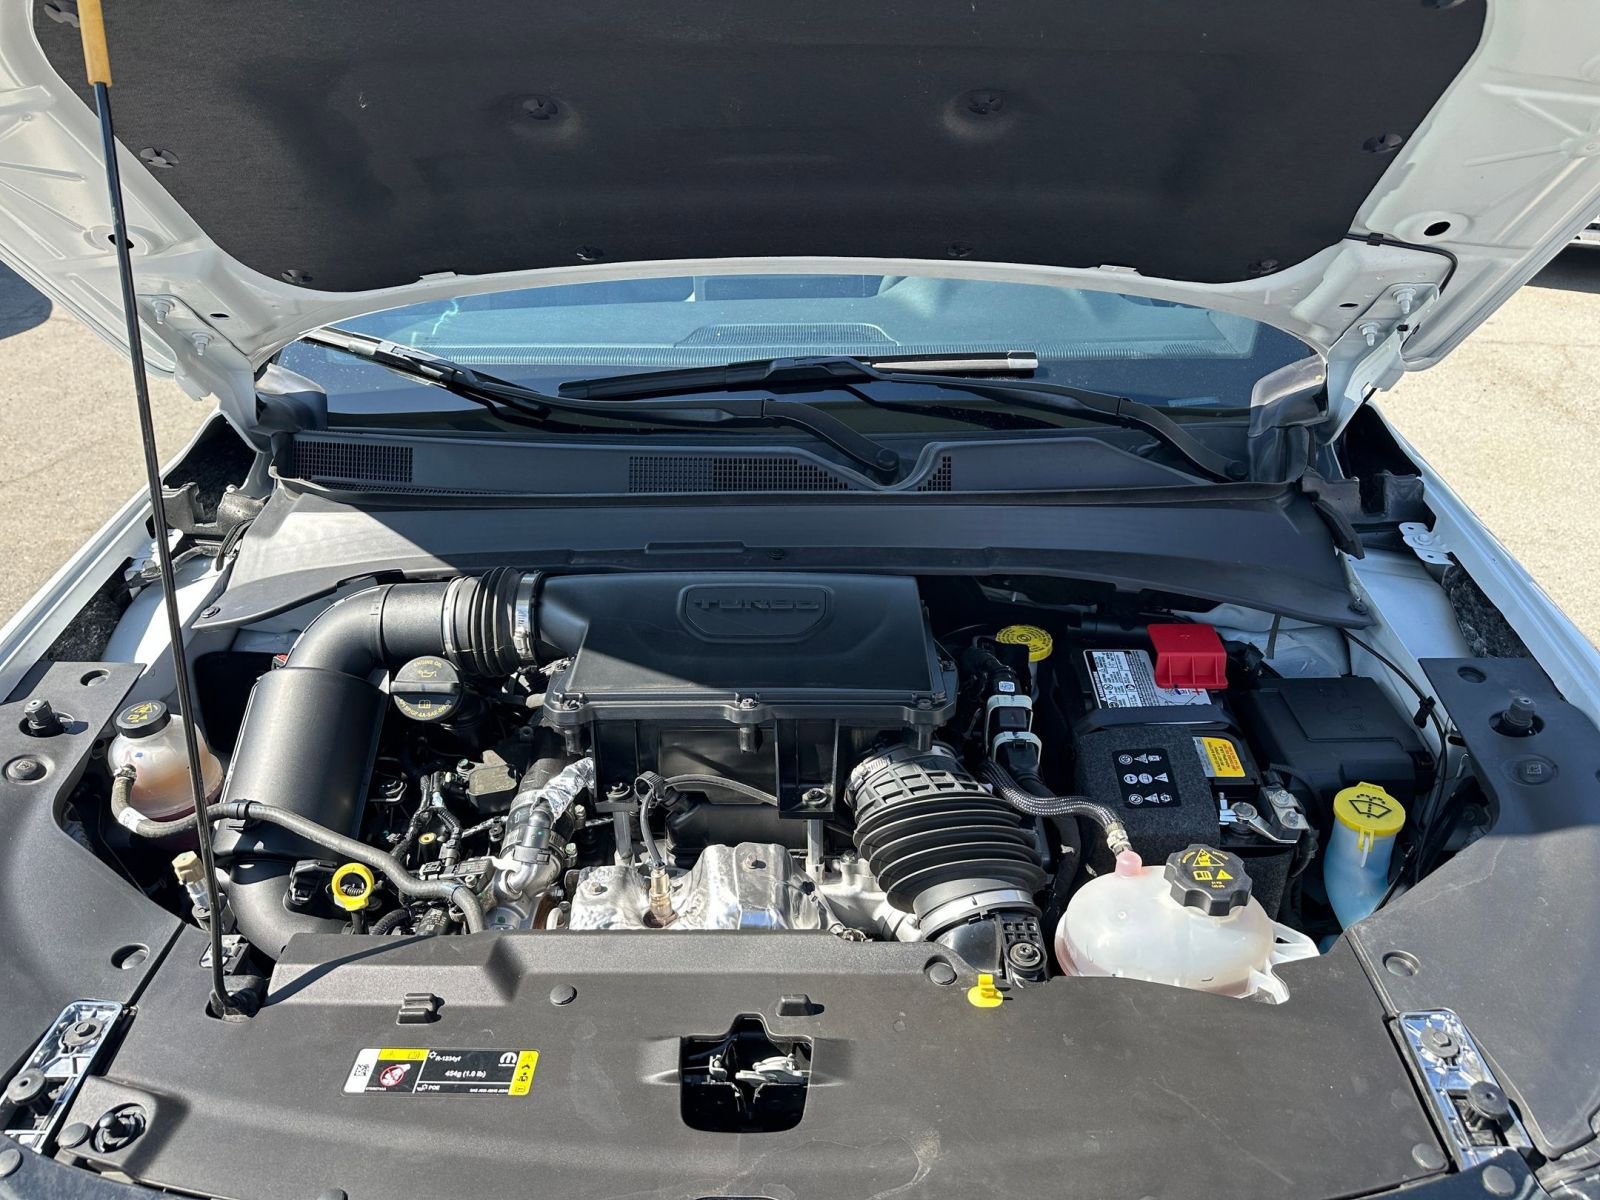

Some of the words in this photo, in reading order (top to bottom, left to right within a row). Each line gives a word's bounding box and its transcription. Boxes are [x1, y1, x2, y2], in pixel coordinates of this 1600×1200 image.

[694, 599, 819, 610] TURBO
[434, 661, 443, 669] OIL
[444, 1070, 462, 1078] 454g
